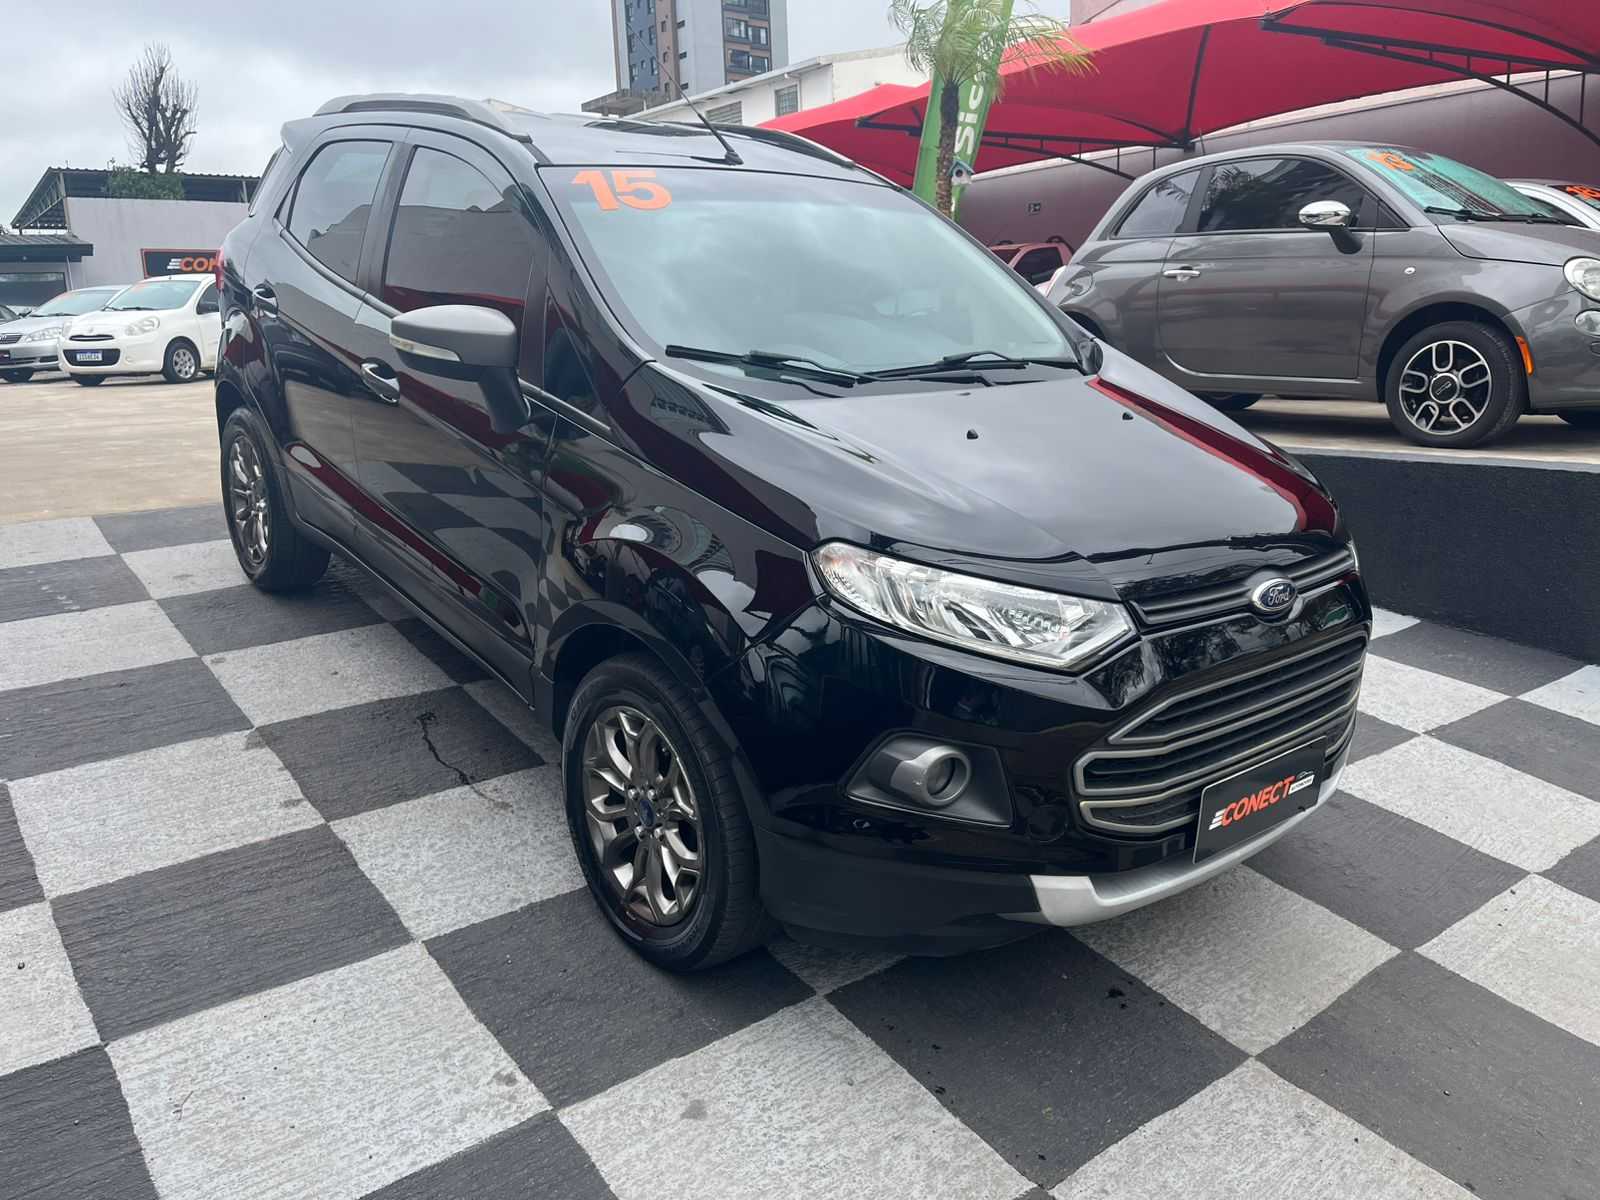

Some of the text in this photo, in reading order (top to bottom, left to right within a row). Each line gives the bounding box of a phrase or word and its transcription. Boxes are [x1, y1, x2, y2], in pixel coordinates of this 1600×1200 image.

[571, 169, 673, 211] 15
[1267, 585, 1290, 606] Ford
[1222, 775, 1296, 826] CONECT
